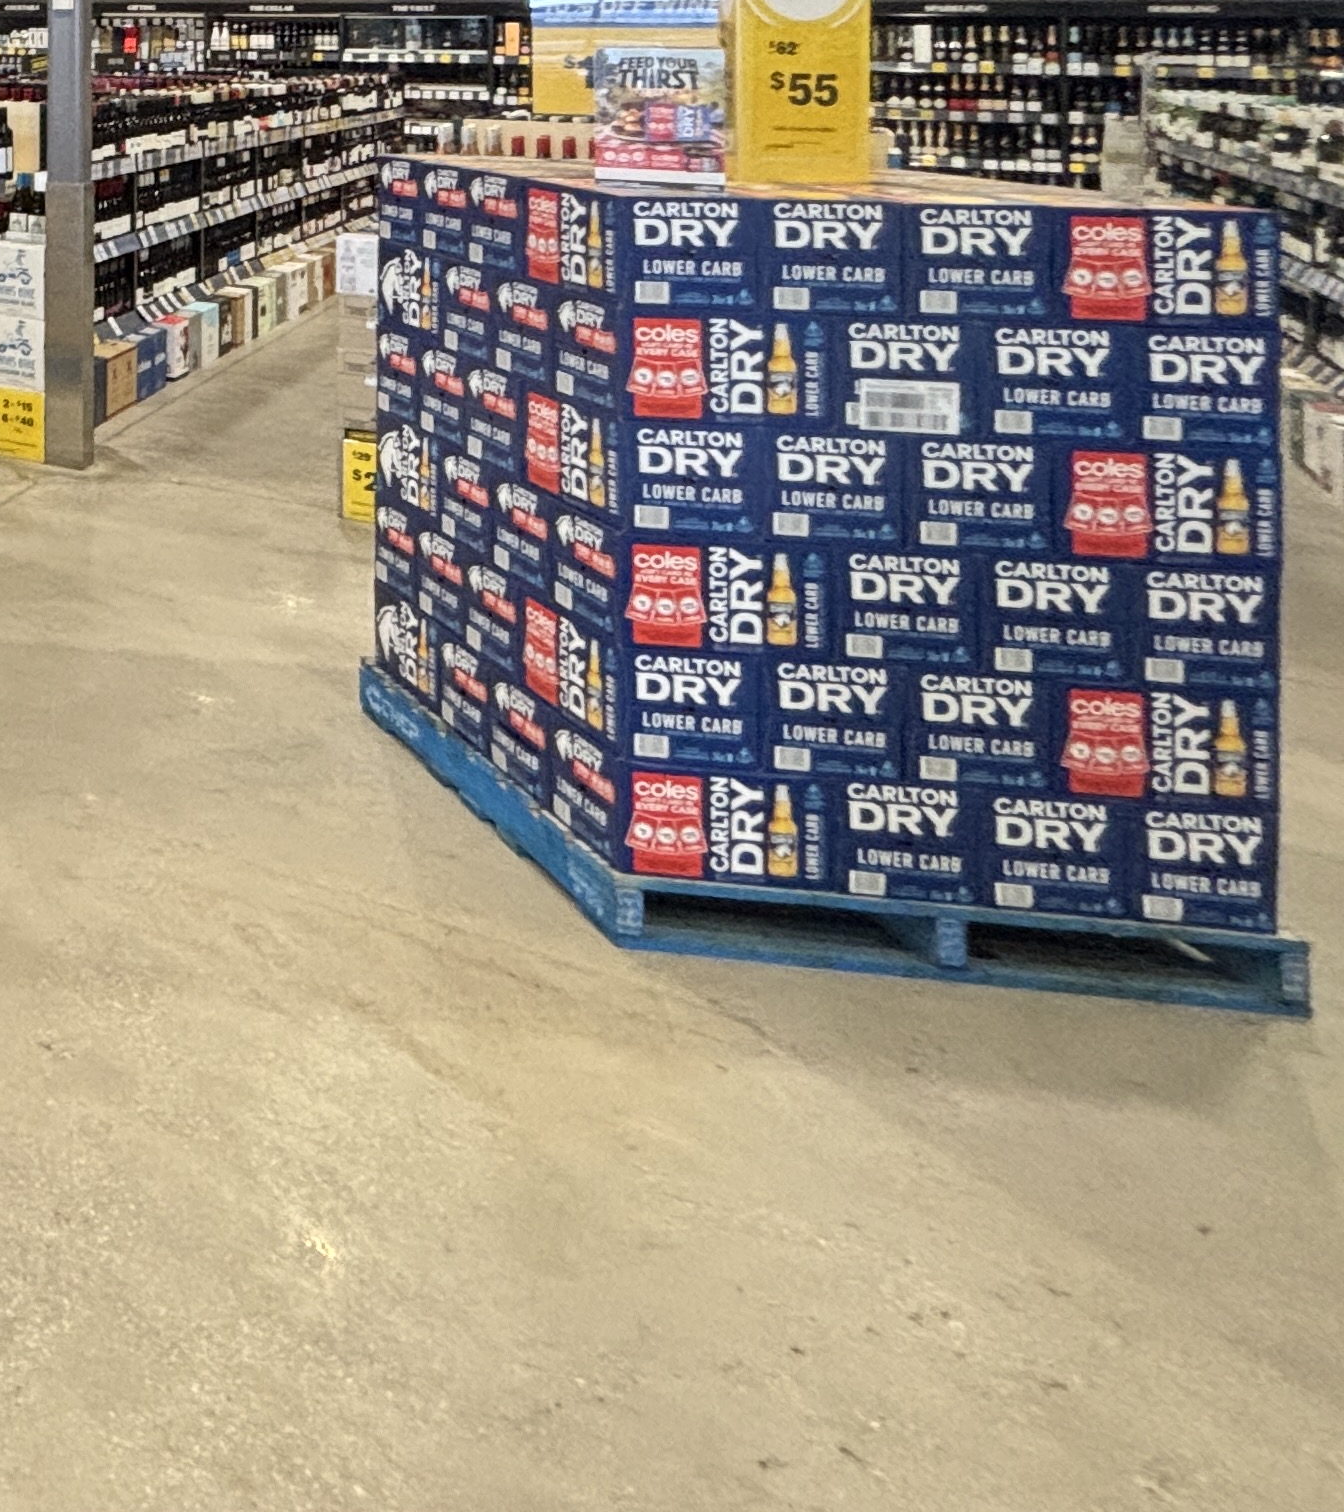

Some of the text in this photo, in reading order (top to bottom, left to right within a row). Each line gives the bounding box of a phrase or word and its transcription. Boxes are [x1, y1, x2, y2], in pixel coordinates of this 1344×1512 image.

[619, 56, 698, 70] FEED YOUR
[616, 68, 700, 89] THIRST
[770, 71, 839, 107] $55
[633, 202, 739, 223] CARLTON
[774, 204, 883, 224] CARLTON
[920, 208, 1033, 229] CARLTON
[634, 219, 739, 248] DRY
[774, 222, 883, 251] DRY
[921, 225, 1033, 257] DRY
[1072, 222, 1143, 244] coles
[643, 259, 742, 277] LOWER CARB
[782, 265, 886, 284] LOWER CARB
[1153, 216, 1174, 315] CARLTON
[1176, 217, 1214, 316] DRY
[928, 268, 1034, 287] LOWER CARB
[848, 323, 960, 344] CARLTON
[995, 328, 1110, 349] CARLTON
[849, 341, 960, 371] DRY
[1148, 335, 1264, 356] CARLTON
[709, 318, 729, 413] CARLTON
[730, 319, 764, 415] DRY
[996, 347, 1110, 377] DRY
[1149, 354, 1265, 385] DRY
[637, 429, 742, 449] CARLTON
[777, 435, 887, 456] CARLTON
[638, 446, 742, 477] DRY
[922, 442, 1033, 463] CARLTON
[777, 453, 886, 483] DRY
